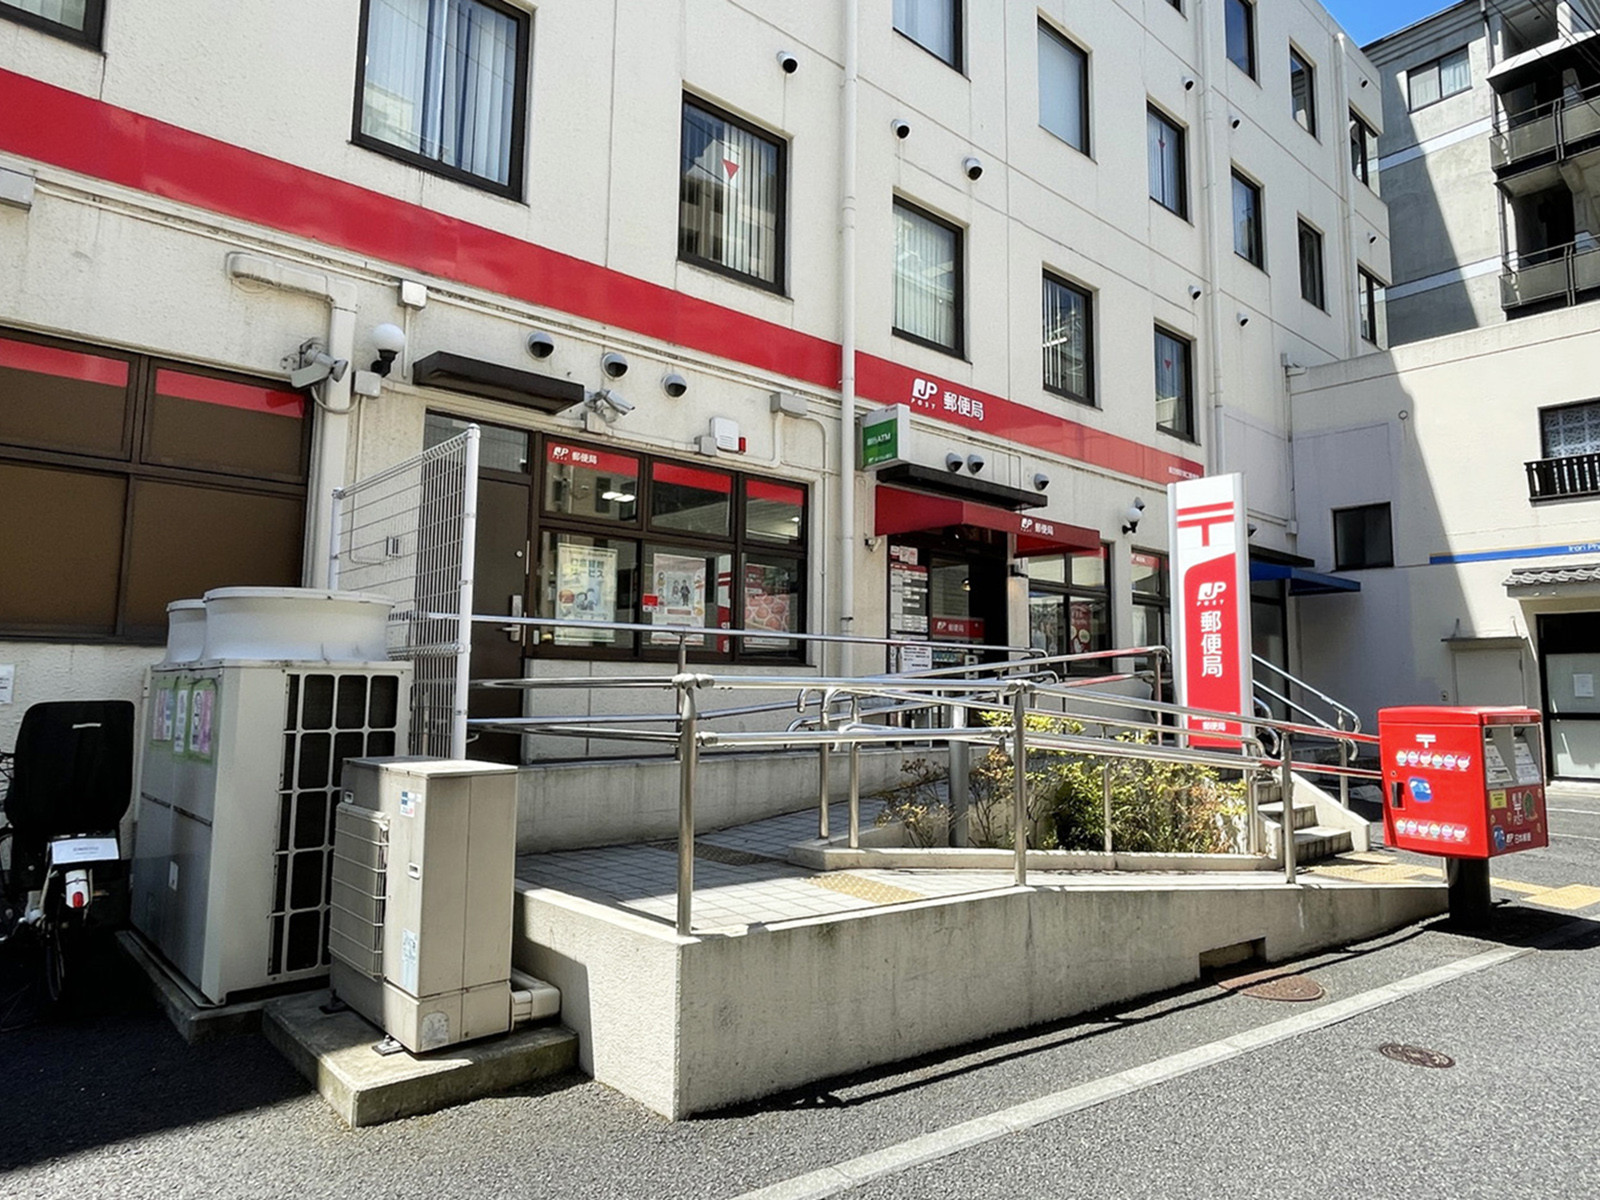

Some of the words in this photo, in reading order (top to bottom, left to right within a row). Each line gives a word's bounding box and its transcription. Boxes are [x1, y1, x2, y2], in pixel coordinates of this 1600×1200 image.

[912, 378, 938, 400] JP
[943, 391, 985, 421] 郵便局
[572, 451, 598, 465] 郵便局
[1197, 581, 1227, 600] JP
[1200, 610, 1223, 677] 郵便局
